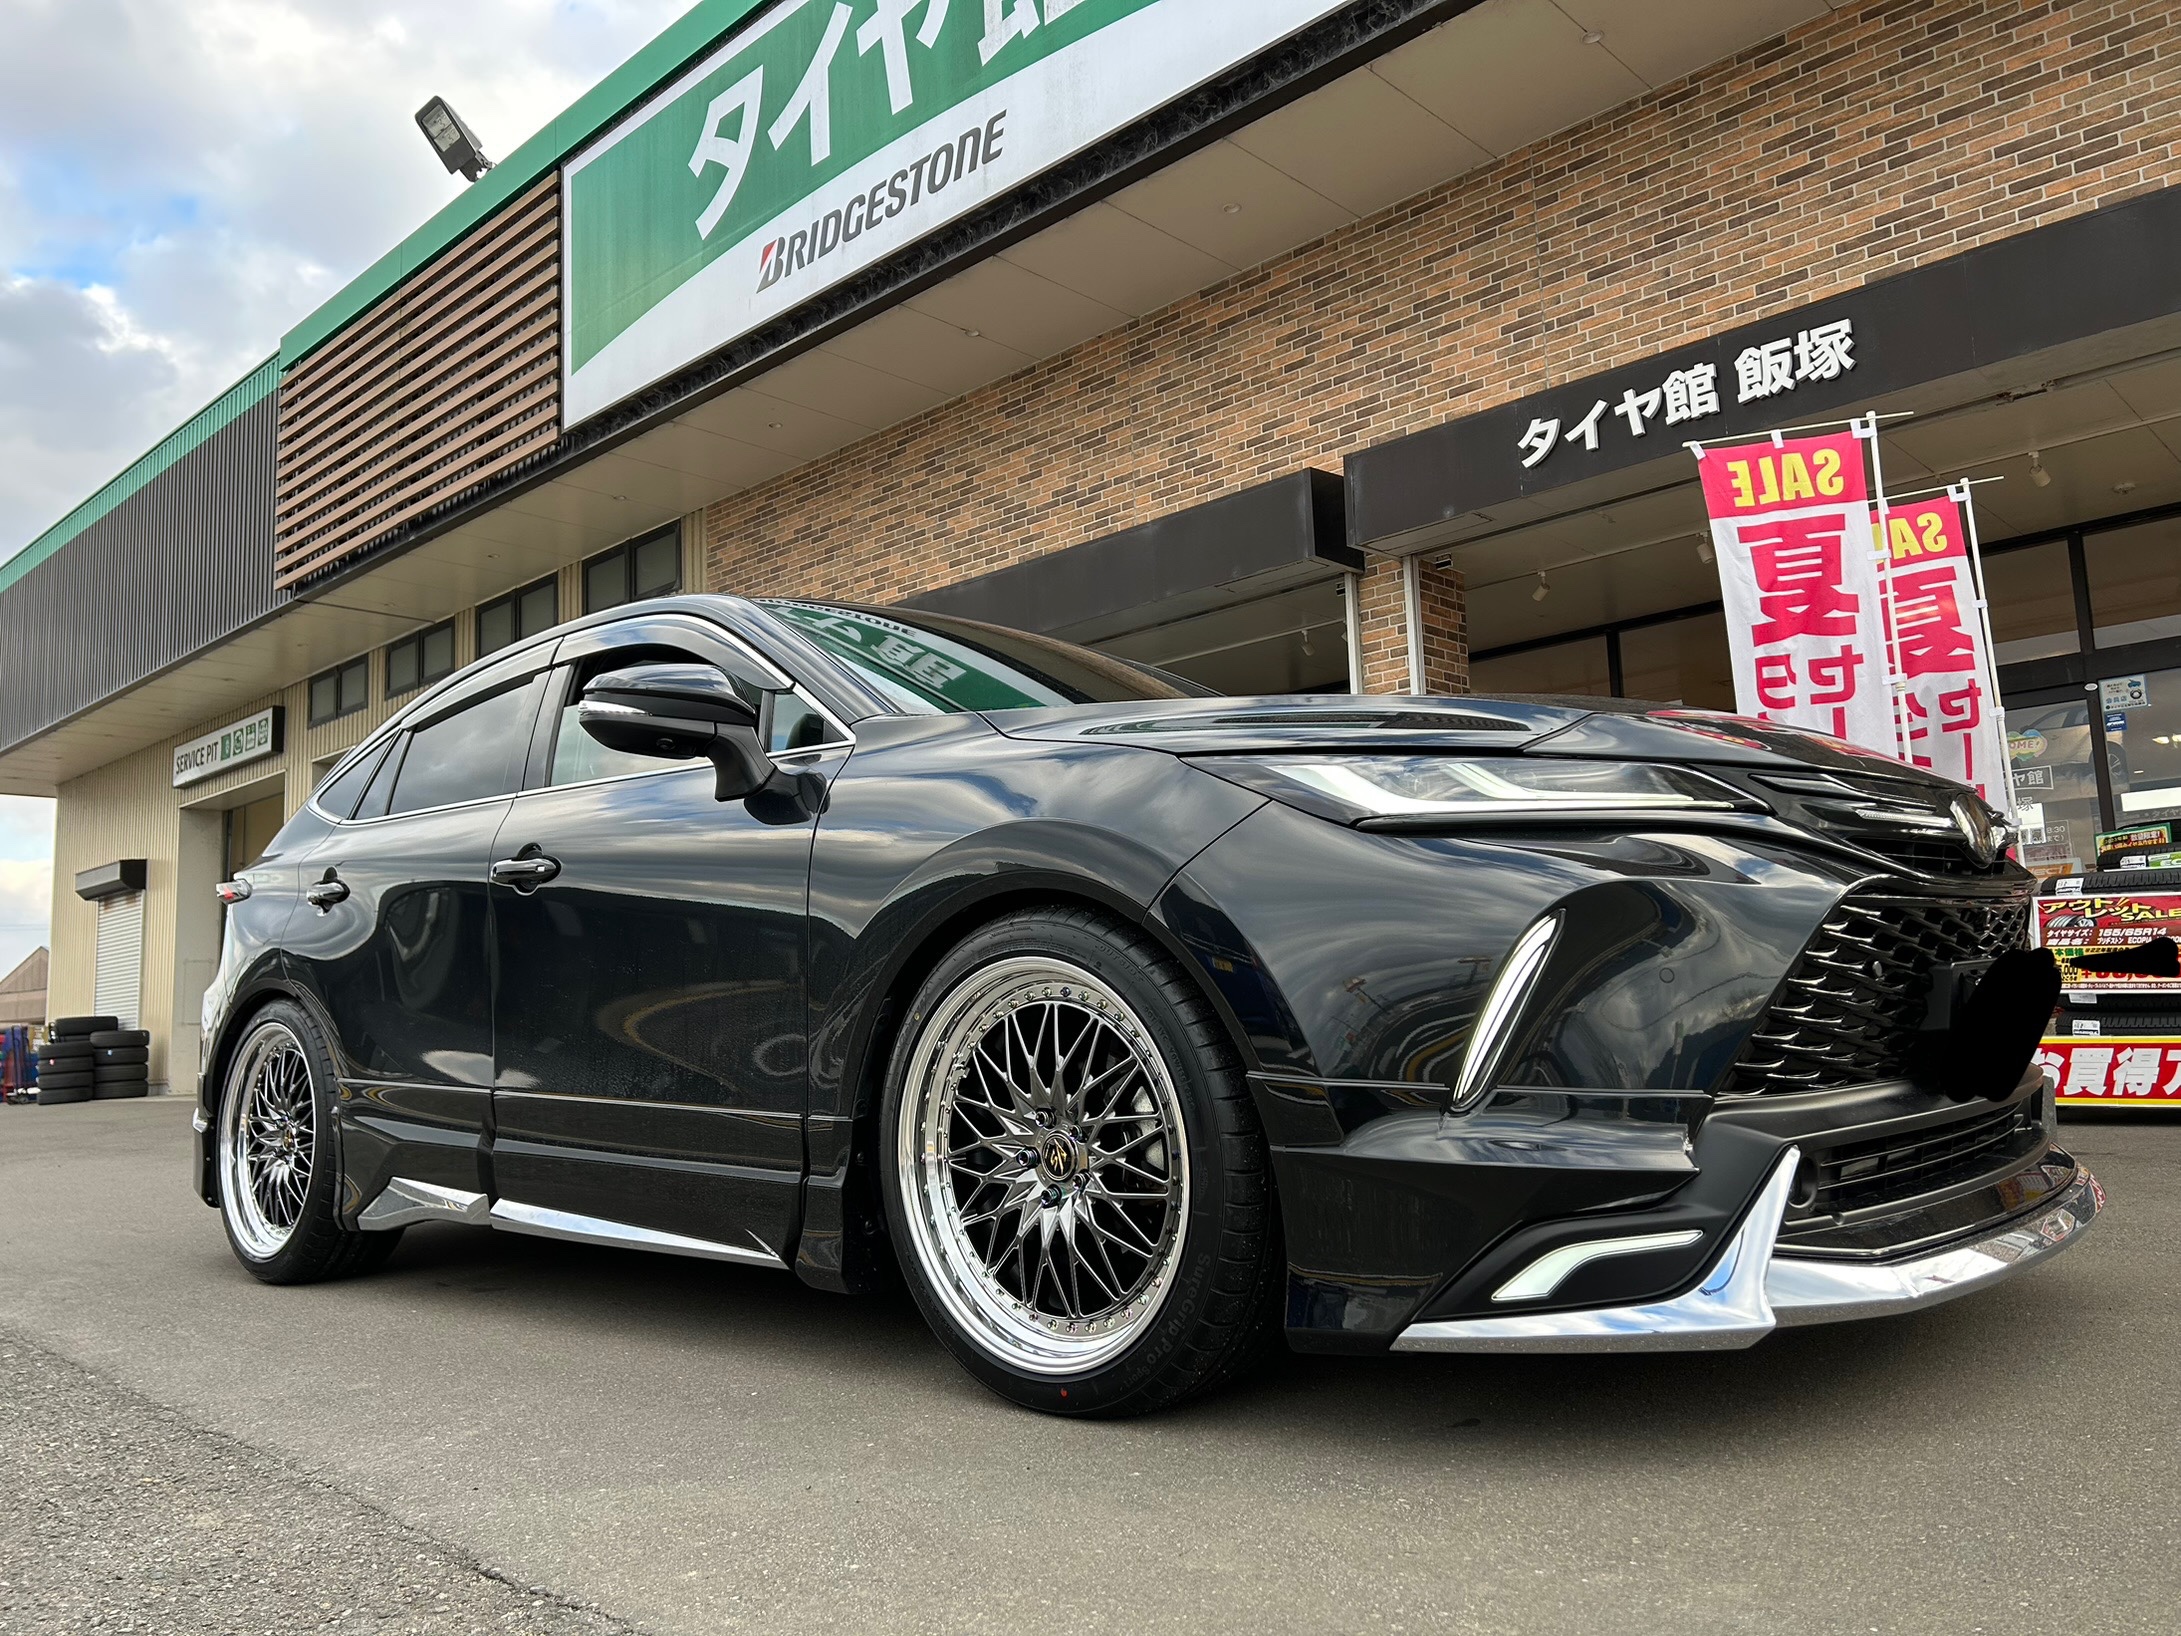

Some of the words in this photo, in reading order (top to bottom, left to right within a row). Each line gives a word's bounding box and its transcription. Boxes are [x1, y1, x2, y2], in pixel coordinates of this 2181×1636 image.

[687, 0, 1083, 240] タイヤ
[755, 108, 1008, 295] BRIDGESTONE
[1516, 363, 1721, 468] タイヤ館
[1735, 318, 1858, 406] 飯塚
[176, 746, 205, 774] SERVICE
[206, 741, 219, 764] PIT
[2120, 907, 2181, 922] SALE
[2098, 927, 2167, 937] 155/65R14
[2050, 948, 2085, 957] 本価格
